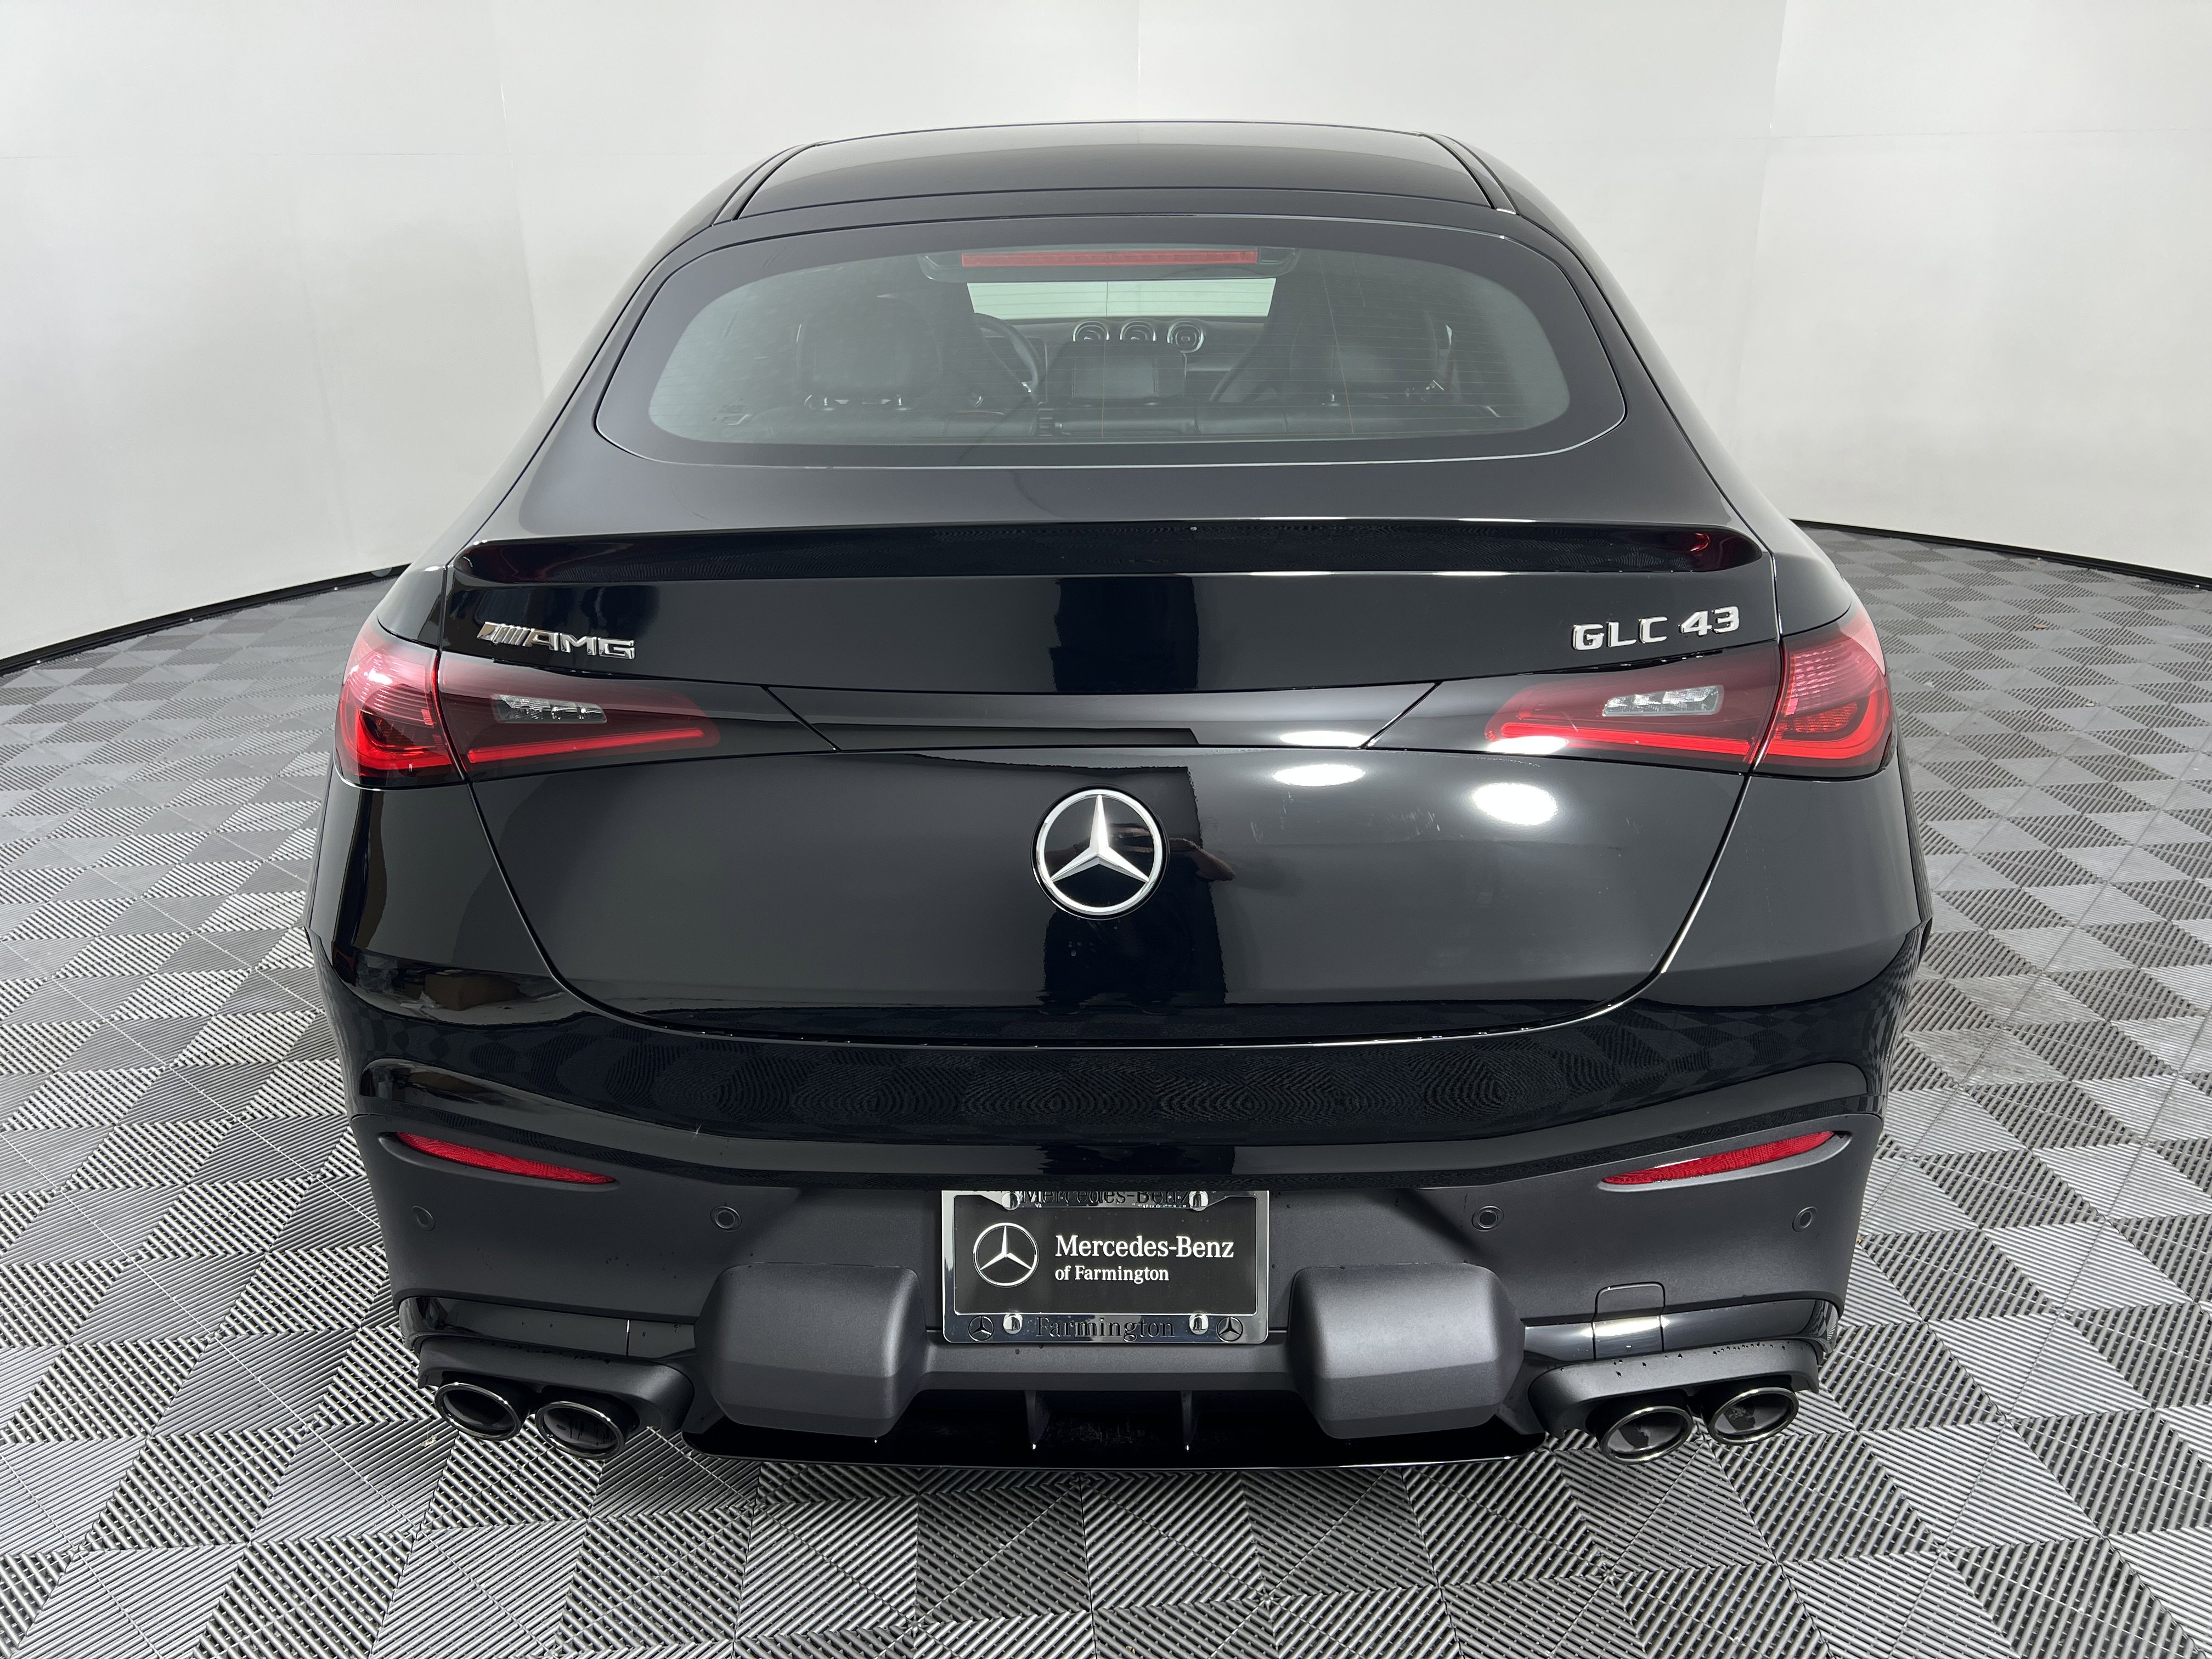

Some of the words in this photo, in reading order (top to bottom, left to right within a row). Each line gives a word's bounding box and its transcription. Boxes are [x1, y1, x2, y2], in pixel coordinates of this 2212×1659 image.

[1572, 616, 1668, 651] GLC
[1678, 606, 1740, 637] 43
[522, 628, 635, 659] AMG
[1055, 1234, 1234, 1258] Mercedes-Benz
[1055, 1265, 1071, 1280] of
[1074, 1265, 1169, 1284] Farmington
[1035, 1317, 1176, 1342] Farmington
